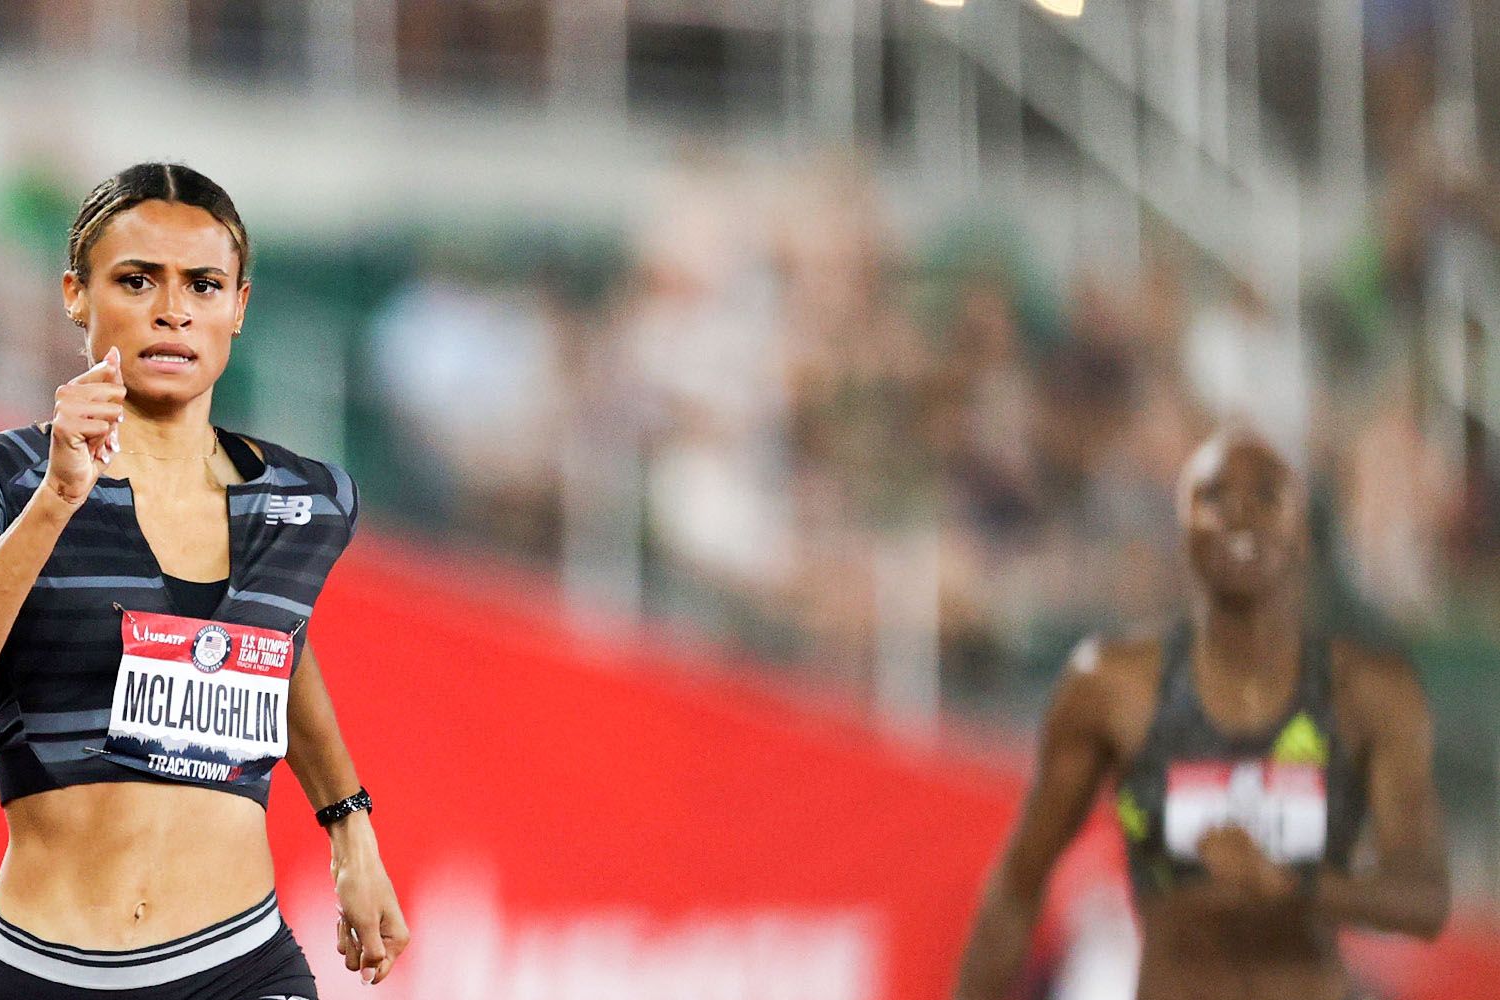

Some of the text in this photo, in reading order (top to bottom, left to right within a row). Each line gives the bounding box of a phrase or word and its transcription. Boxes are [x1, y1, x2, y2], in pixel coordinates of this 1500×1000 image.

[149, 632, 187, 646] USATF
[241, 634, 290, 655] U.S. OLYMPIC
[238, 648, 286, 668] TEAM TRIALS
[121, 671, 279, 744] MCLAUGHLIN
